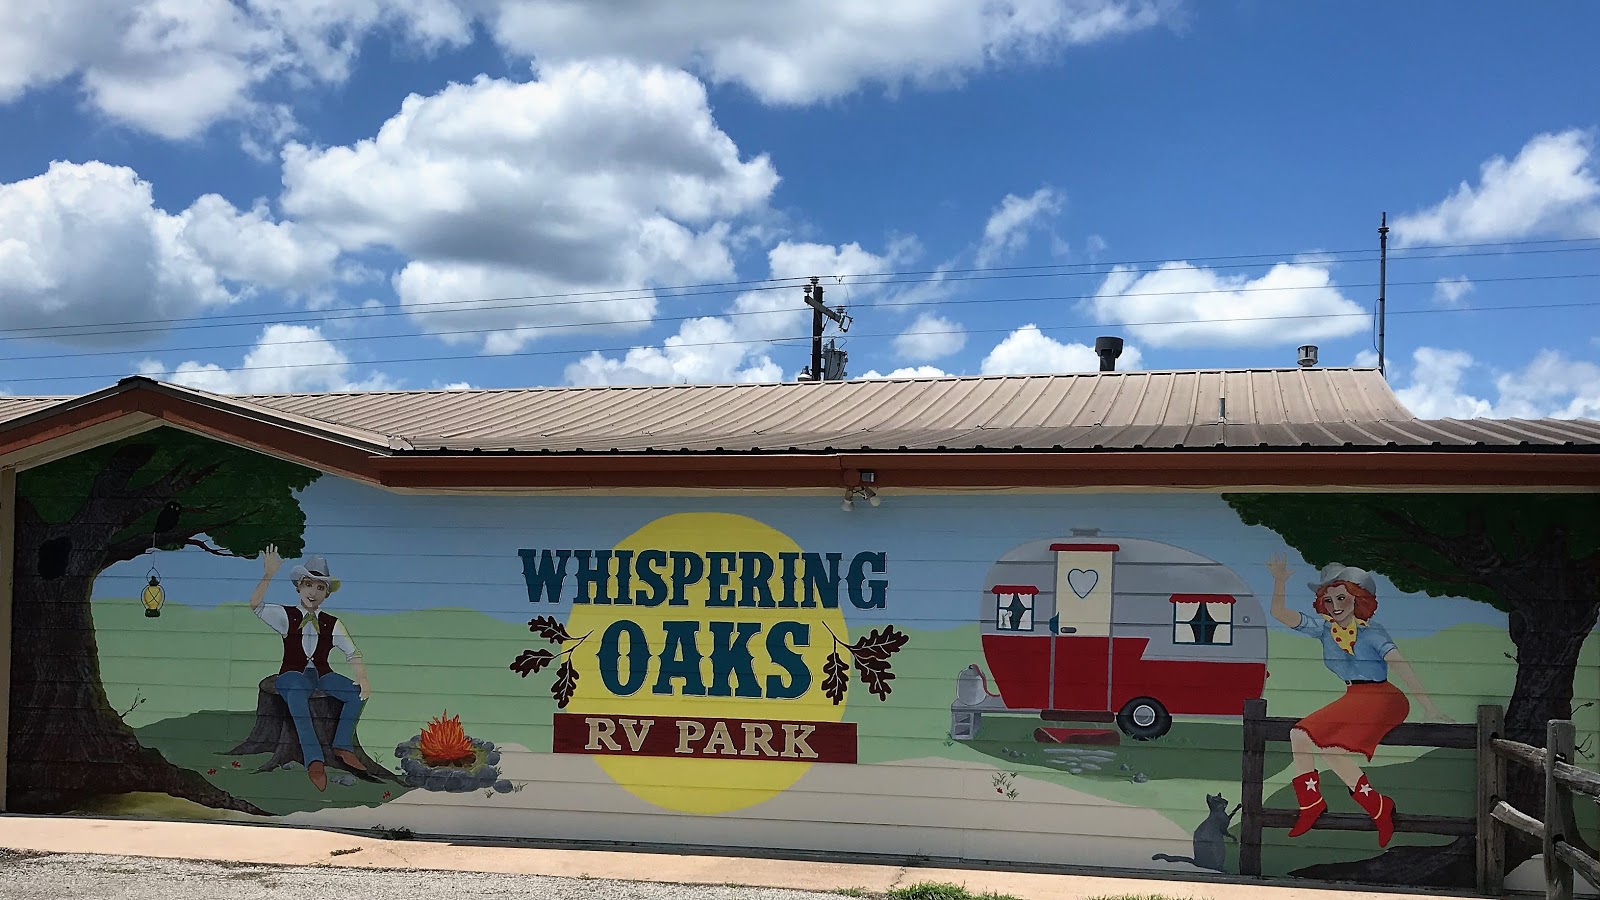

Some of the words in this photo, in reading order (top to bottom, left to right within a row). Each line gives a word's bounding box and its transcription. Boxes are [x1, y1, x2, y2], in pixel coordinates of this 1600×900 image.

[518, 548, 888, 610] WHISPERING
[596, 619, 813, 699] OAKS
[584, 717, 655, 752] RV
[675, 720, 819, 758] PARK
